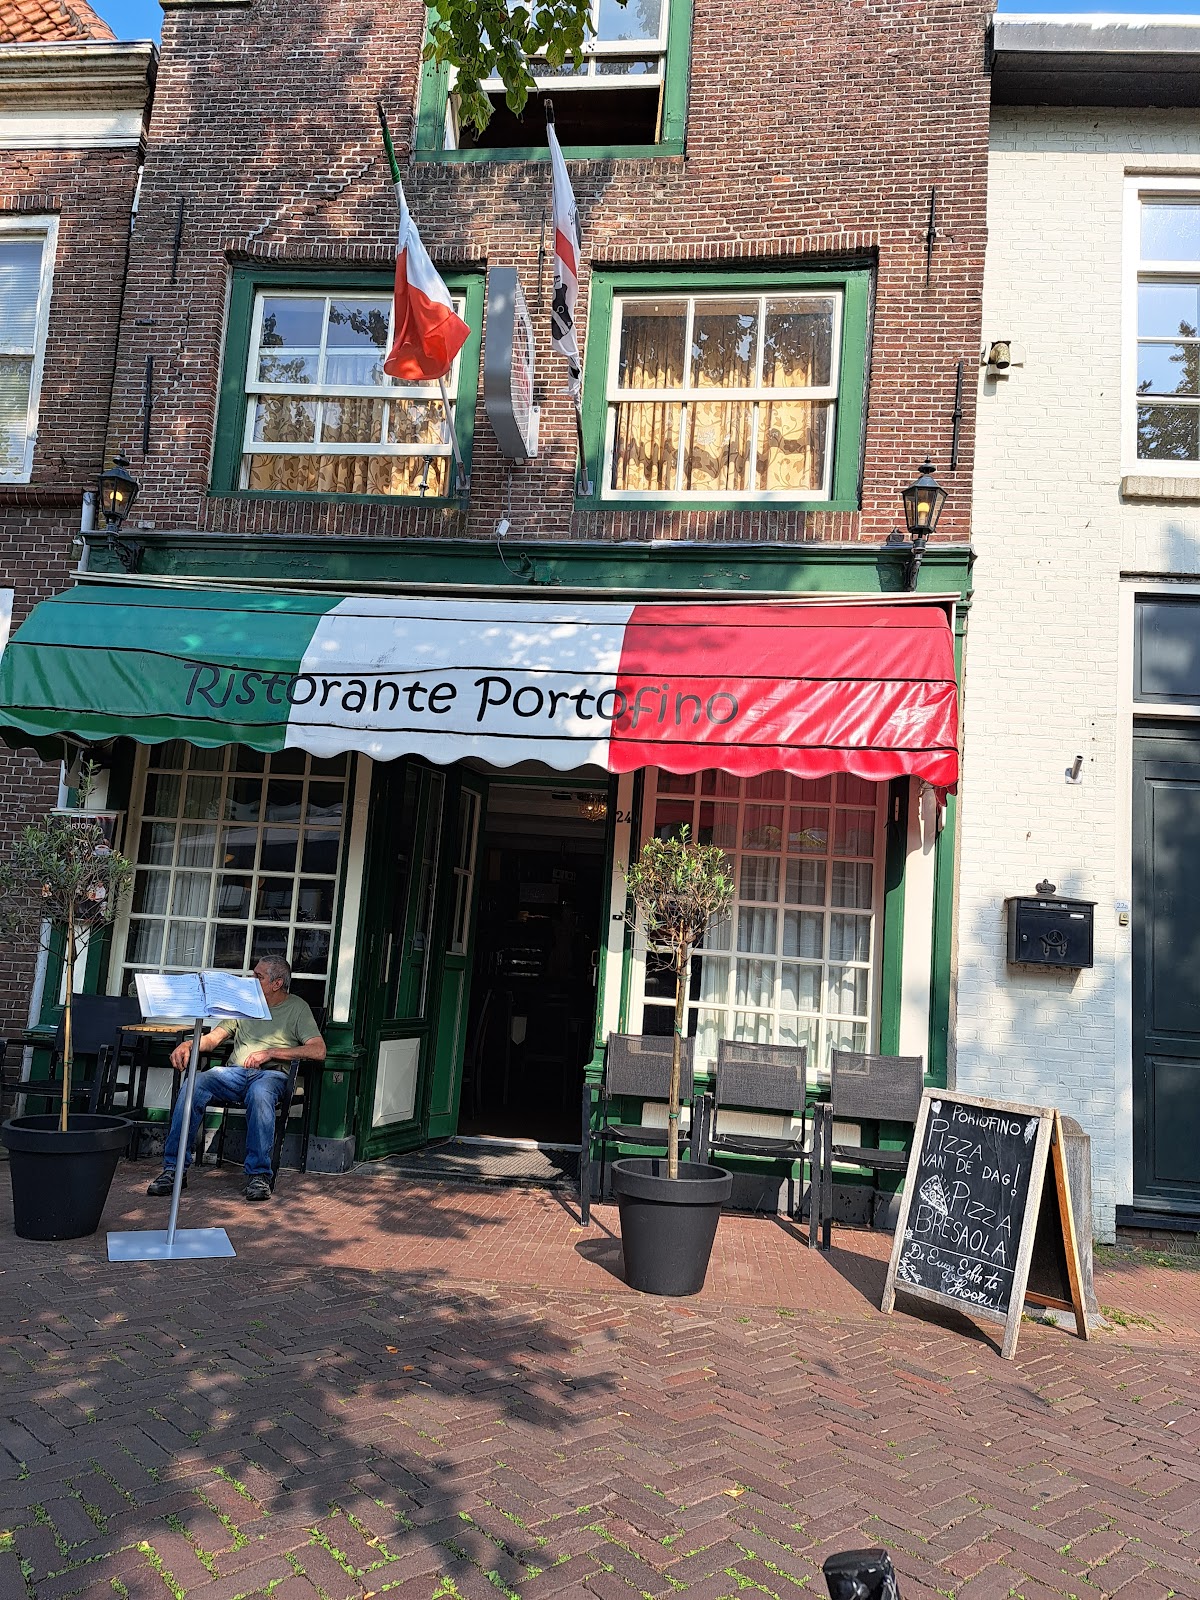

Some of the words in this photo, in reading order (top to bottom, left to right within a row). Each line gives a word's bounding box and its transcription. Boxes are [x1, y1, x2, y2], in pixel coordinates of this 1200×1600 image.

[183, 663, 457, 714] Ristorante
[474, 676, 739, 728] Portofino
[616, 810, 631, 823] 24
[926, 1118, 982, 1161] PIZZA
[952, 1104, 1021, 1135] PORTOFINO
[922, 1152, 947, 1169] VAN
[956, 1158, 974, 1175] DE
[982, 1163, 1021, 1197] DAG!
[950, 1180, 1012, 1238] PIZZA
[914, 1204, 1007, 1265] BRESAOLA
